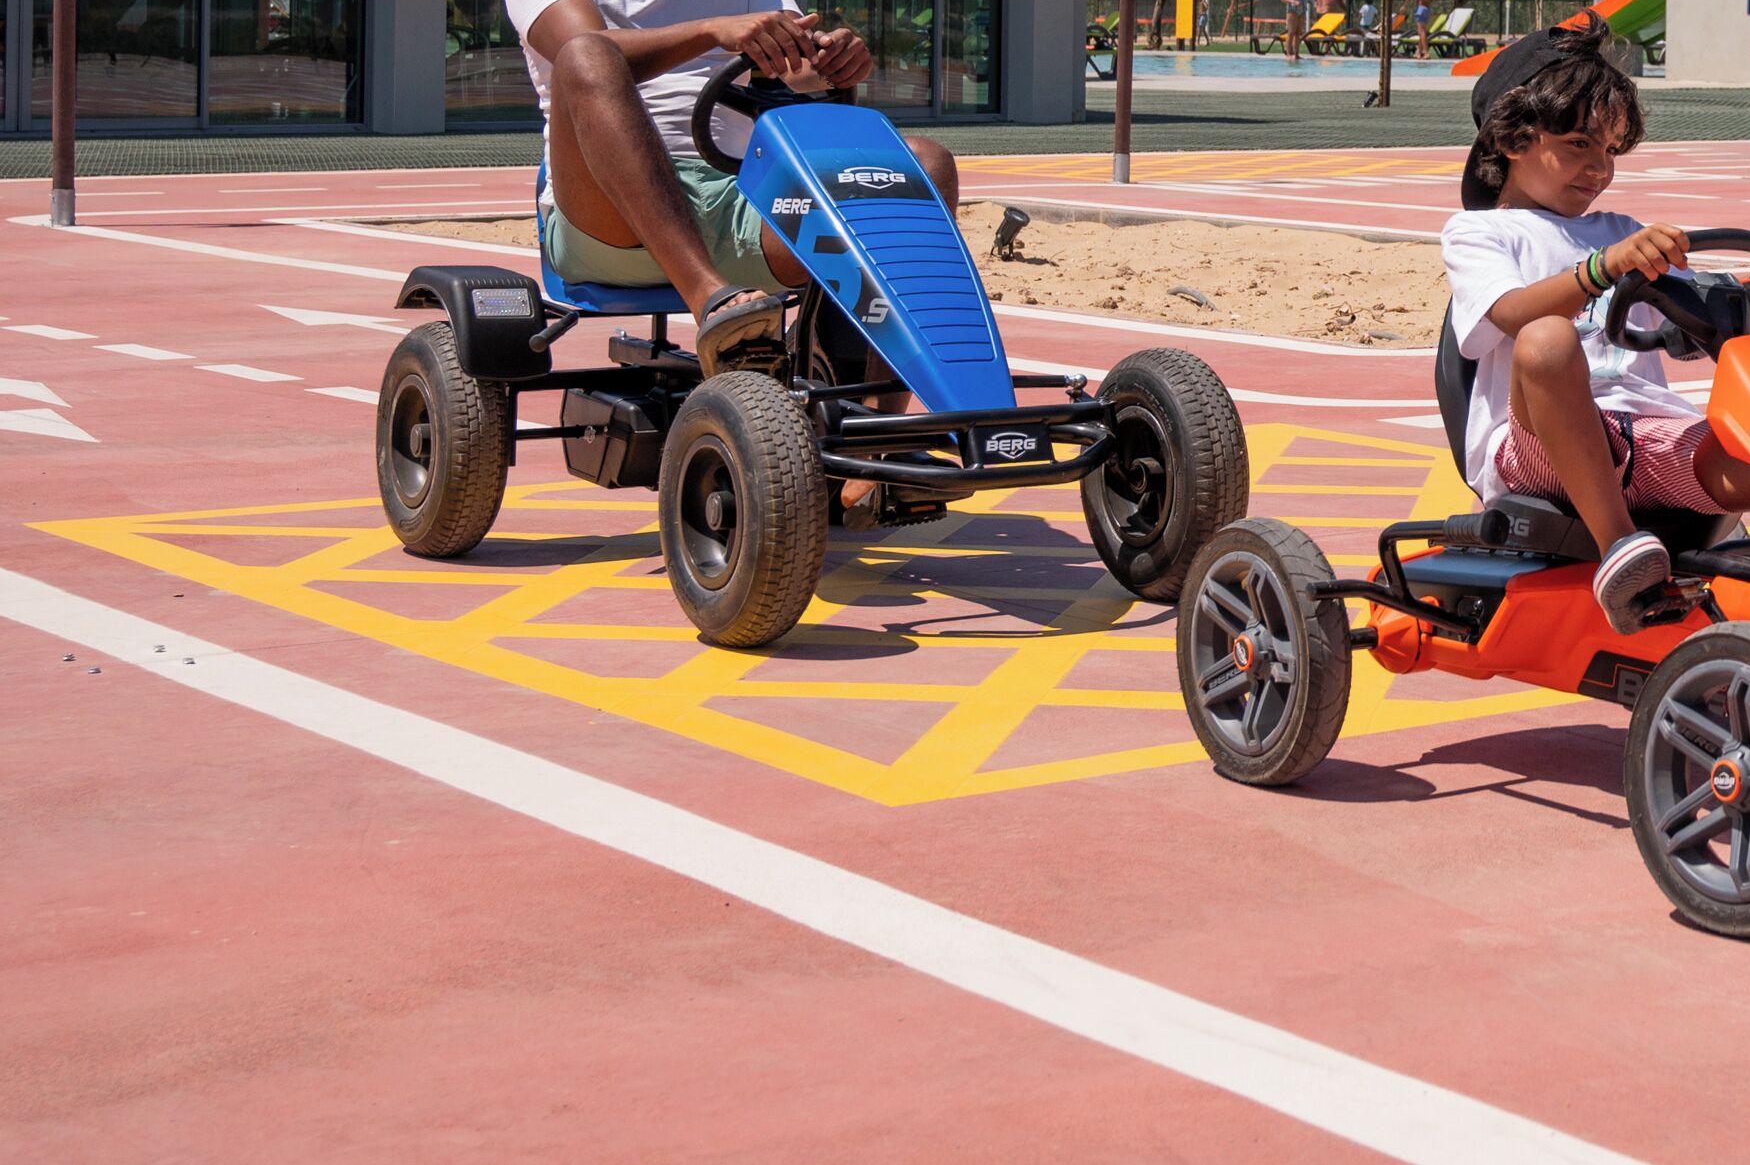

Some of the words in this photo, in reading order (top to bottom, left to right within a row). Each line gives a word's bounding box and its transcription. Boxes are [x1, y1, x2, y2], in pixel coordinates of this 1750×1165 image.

[837, 172, 907, 183] BERG
[771, 197, 812, 215] BERG
[986, 438, 1036, 452] BERG
